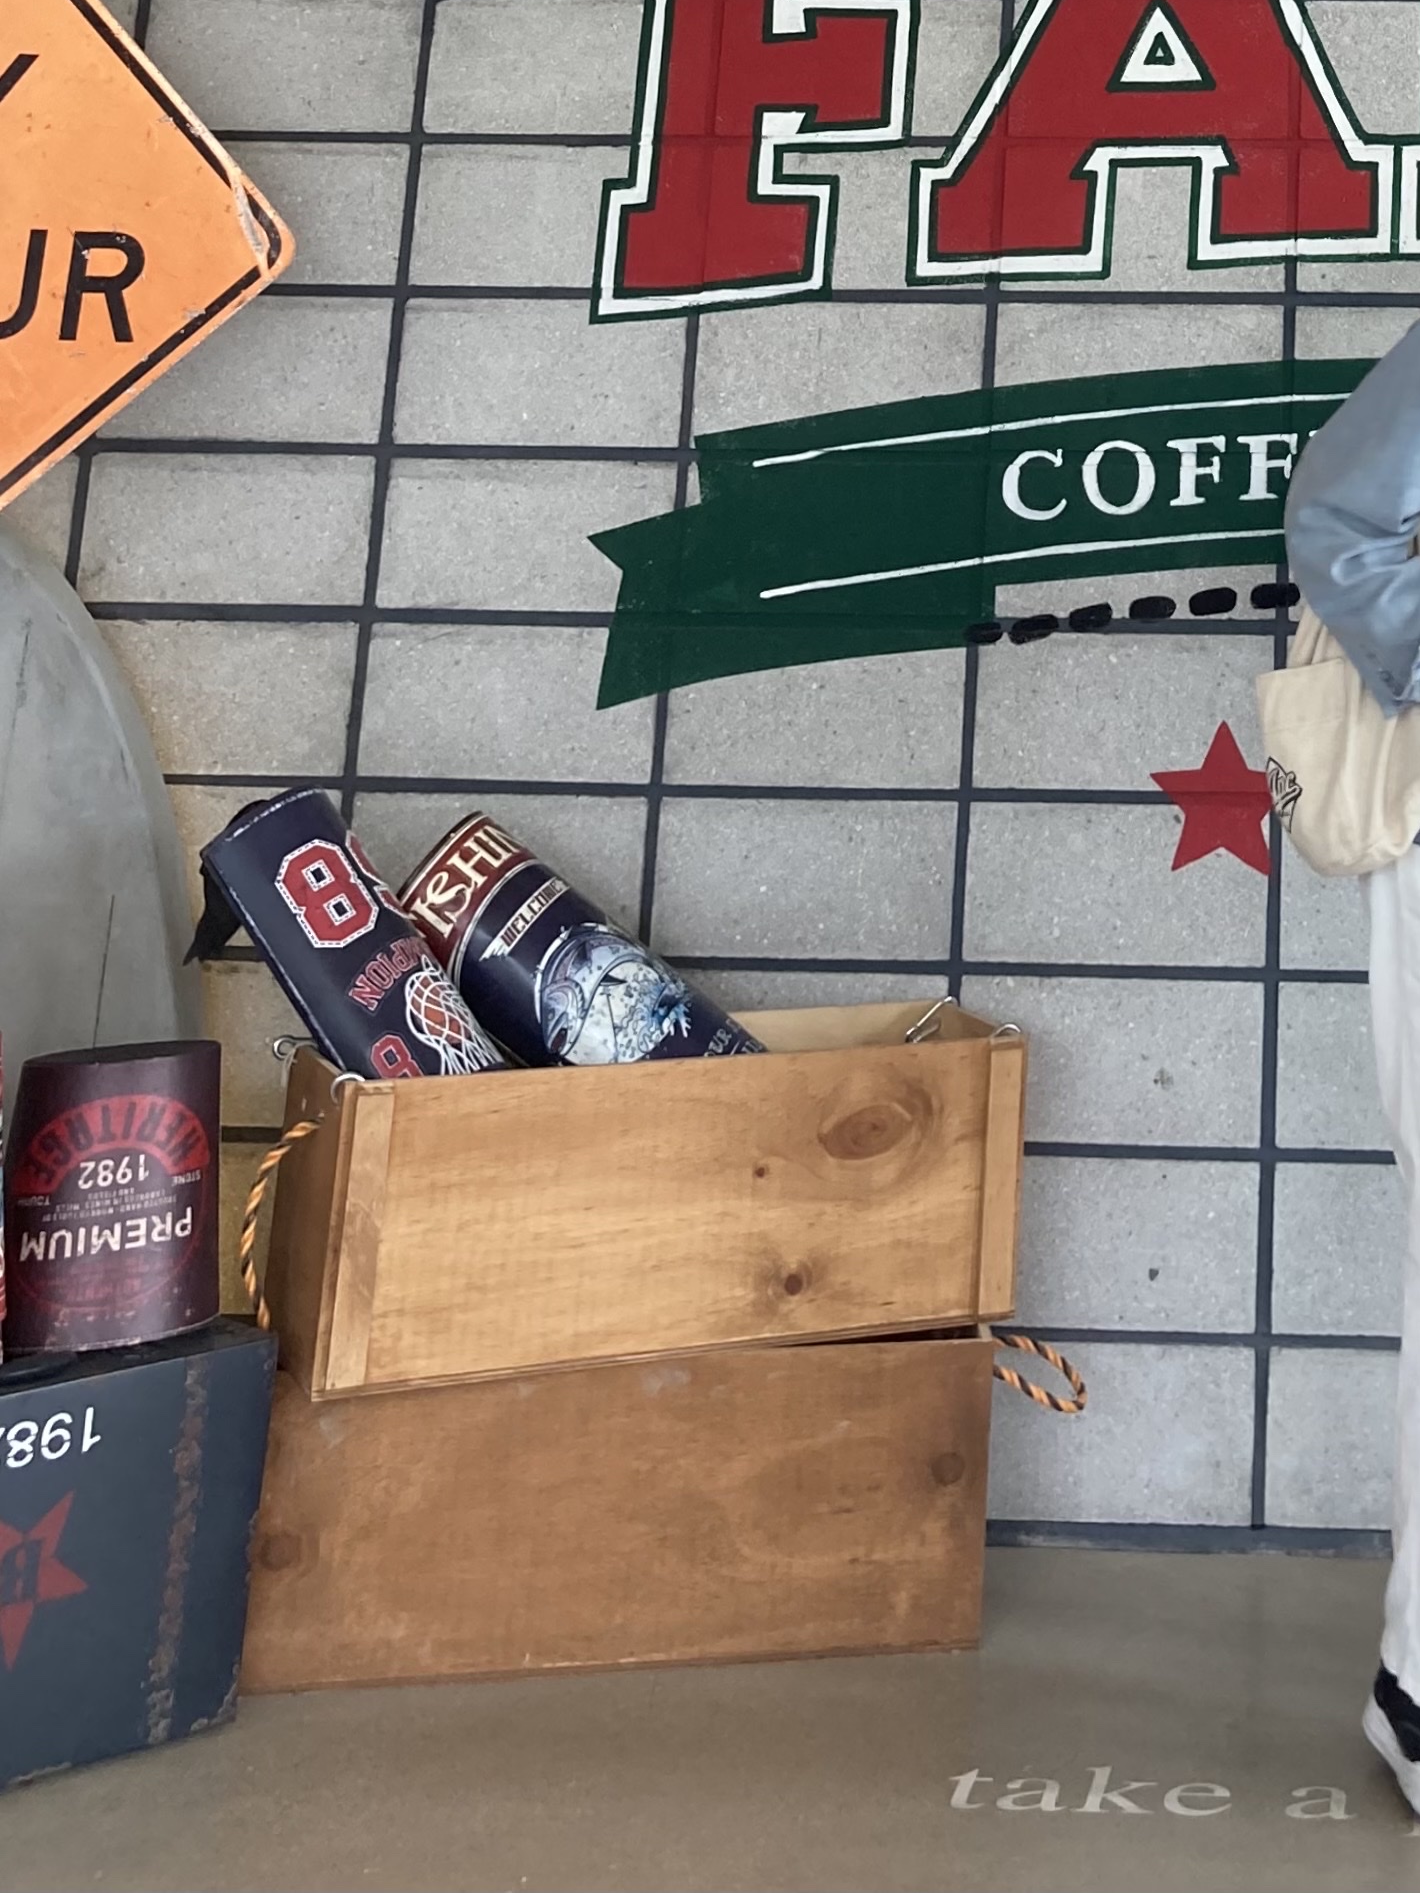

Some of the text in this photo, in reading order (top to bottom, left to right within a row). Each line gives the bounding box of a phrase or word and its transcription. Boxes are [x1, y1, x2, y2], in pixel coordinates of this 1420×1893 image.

[1001, 429, 1320, 522] COFF
[78, 1154, 149, 1190] 1982
[19, 1207, 192, 1262] PREMIUM
[0, 1406, 102, 1468] 198
[948, 1765, 1232, 1817] take
[1284, 1783, 1356, 1821] a
